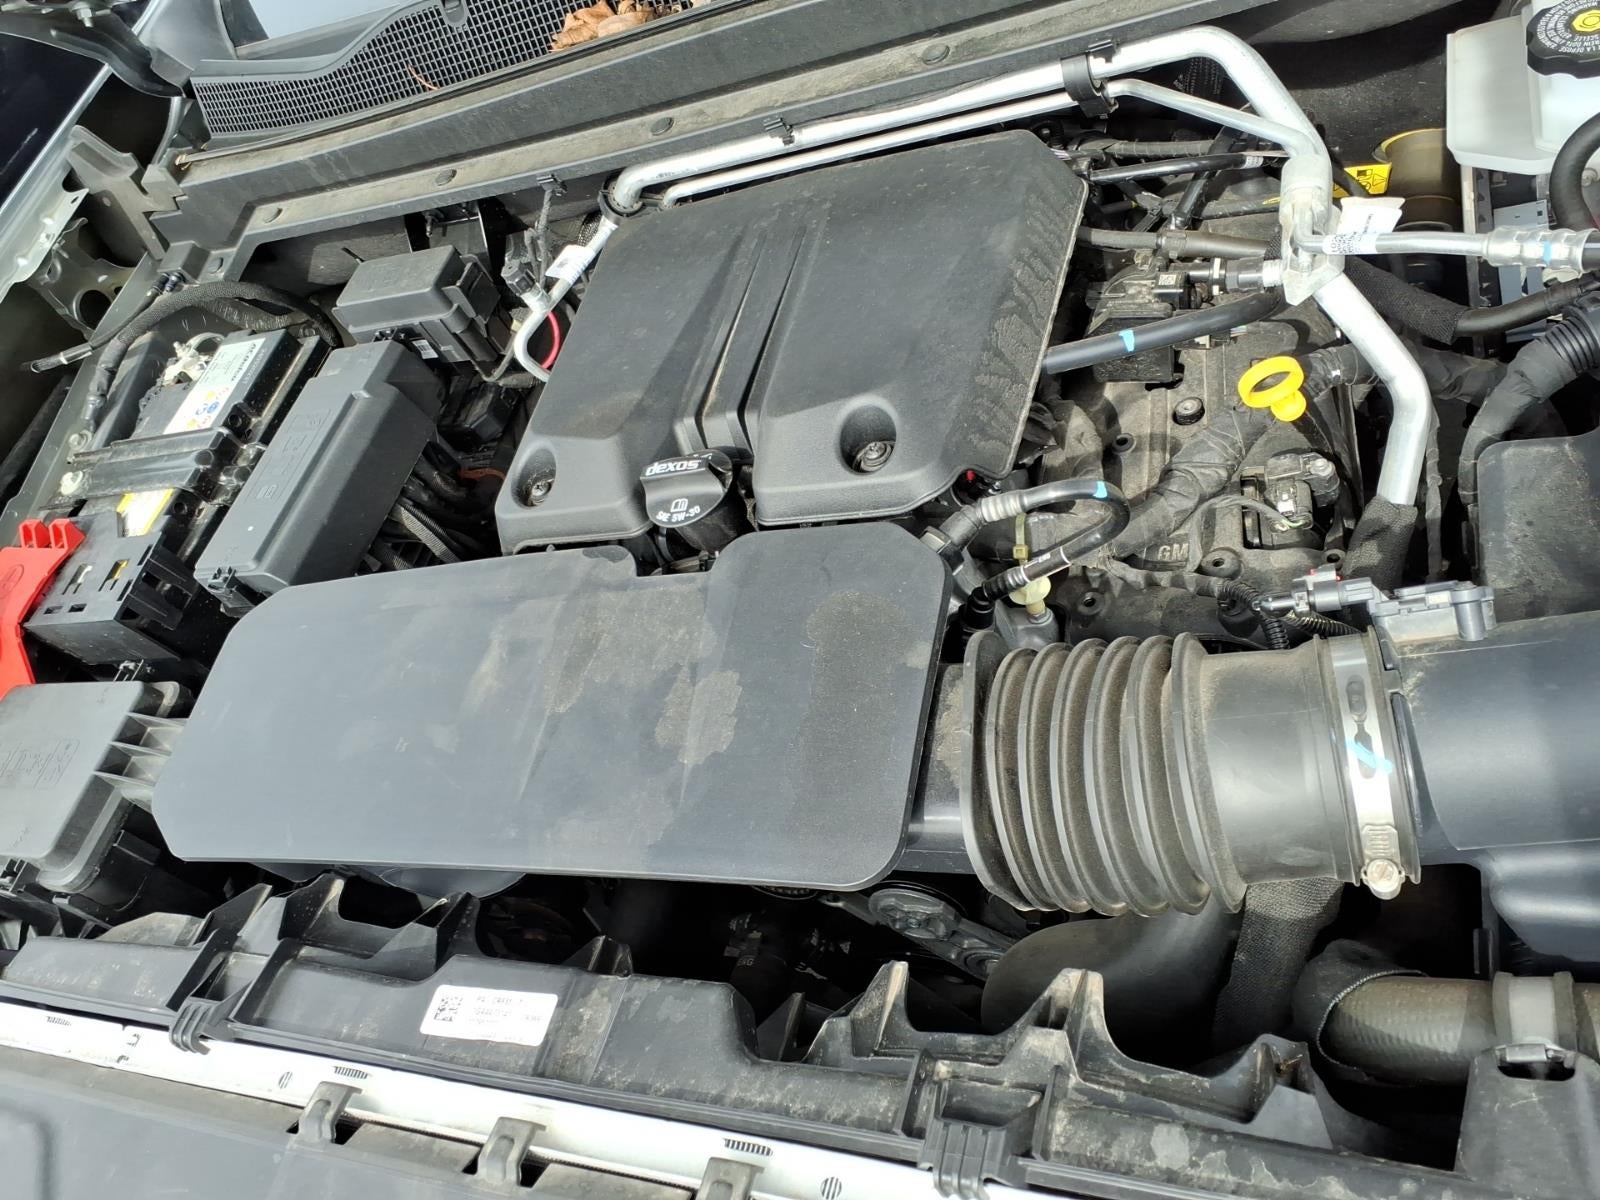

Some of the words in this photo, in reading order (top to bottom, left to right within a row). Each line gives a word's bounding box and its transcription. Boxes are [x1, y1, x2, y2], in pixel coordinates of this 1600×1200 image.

[646, 460, 702, 476] dexos
[671, 506, 700, 522] 5W-30
[1158, 544, 1188, 560] GM
